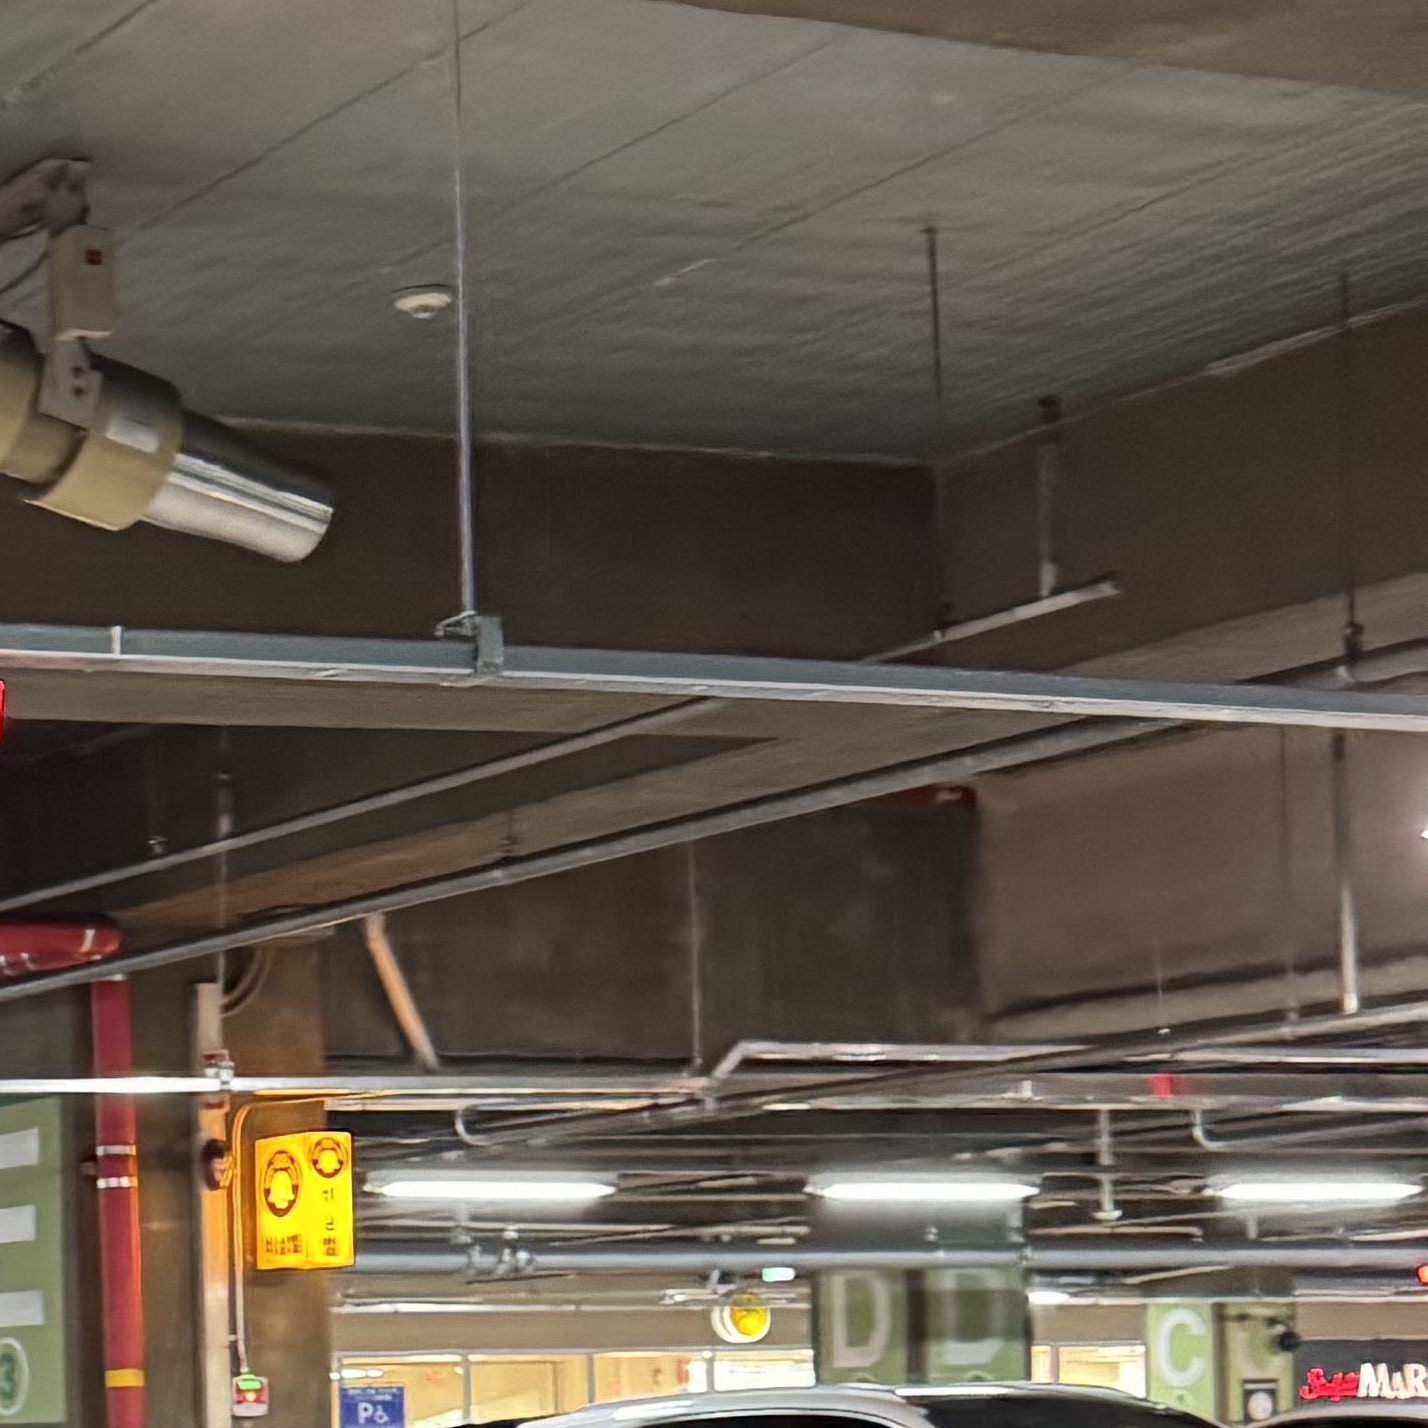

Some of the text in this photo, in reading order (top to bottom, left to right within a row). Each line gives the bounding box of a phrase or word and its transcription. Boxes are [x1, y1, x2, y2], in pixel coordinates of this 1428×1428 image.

[832, 1270, 890, 1367] D
[1156, 1308, 1204, 1387] C
[358, 1402, 373, 1424] P
